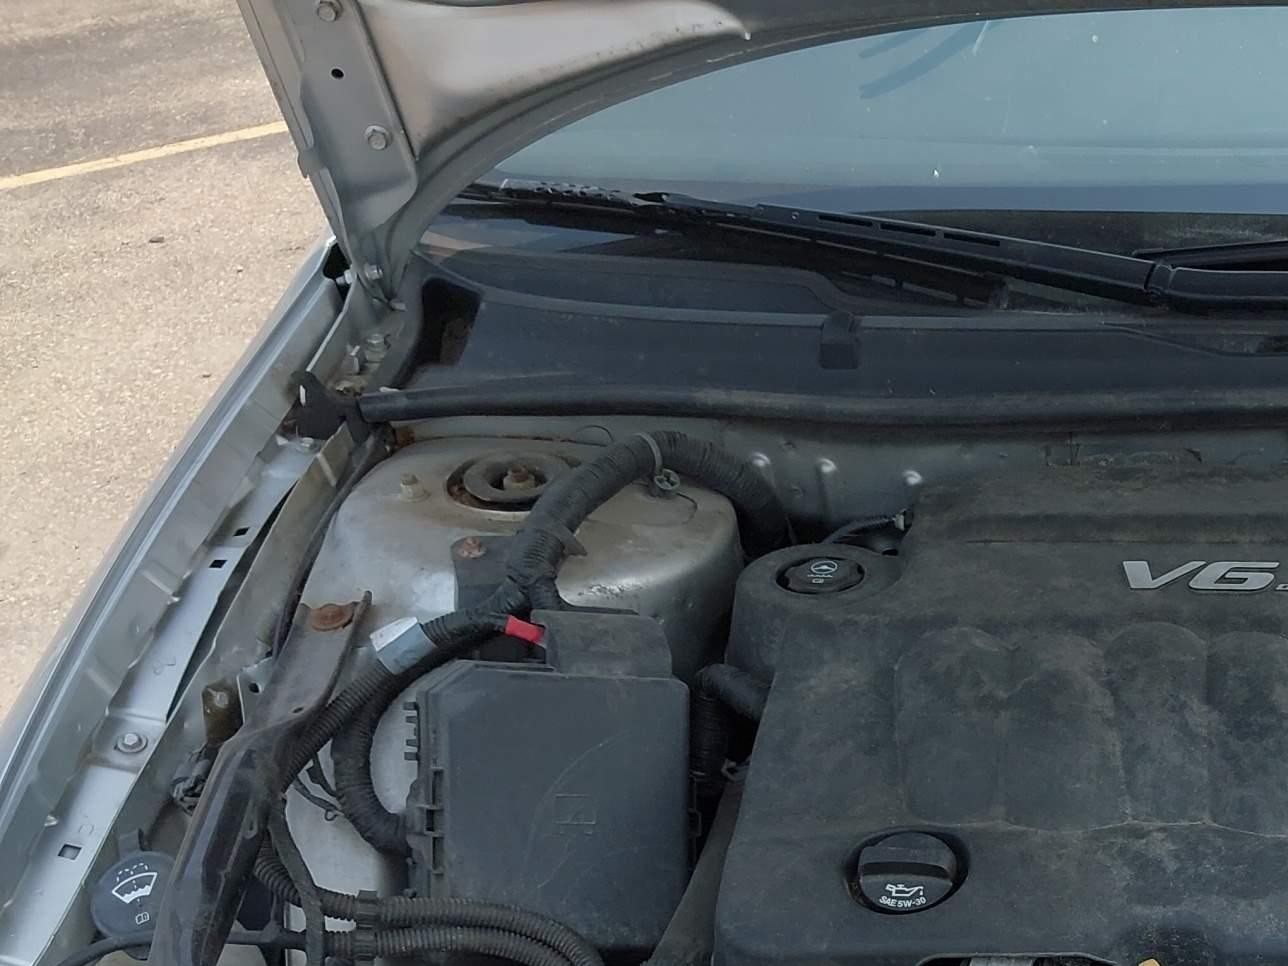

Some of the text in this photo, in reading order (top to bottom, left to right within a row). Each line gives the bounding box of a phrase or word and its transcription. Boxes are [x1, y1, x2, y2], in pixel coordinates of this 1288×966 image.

[1123, 561, 1280, 591] V6
[879, 895, 926, 908] SAE 5W-30
